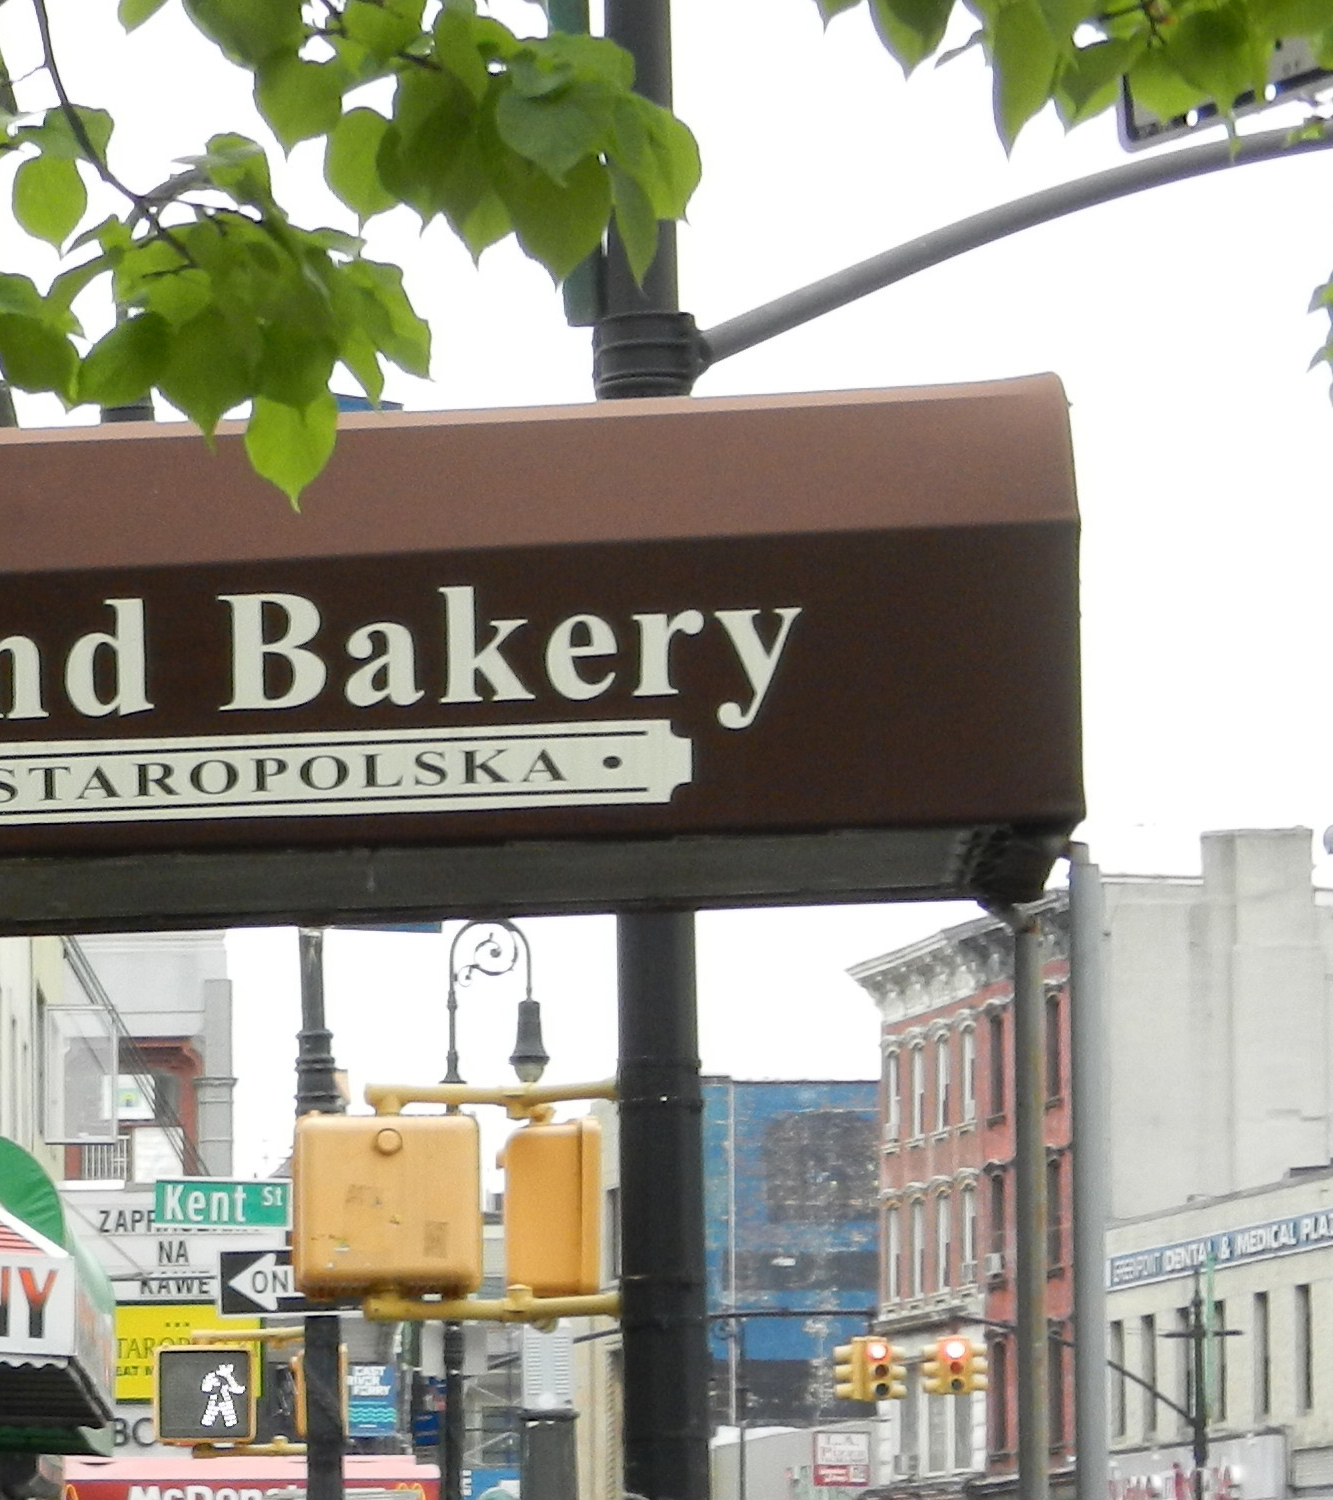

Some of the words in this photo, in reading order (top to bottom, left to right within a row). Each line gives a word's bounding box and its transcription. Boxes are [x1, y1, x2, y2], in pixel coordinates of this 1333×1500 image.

[216, 585, 804, 730] Bakery
[162, 1183, 247, 1223] Kent
[261, 1185, 284, 1207] St
[158, 1240, 190, 1265] NA
[1219, 1236, 1232, 1261] &
[1235, 1222, 1299, 1256] MEDICAL
[251, 1269, 290, 1295] ON
